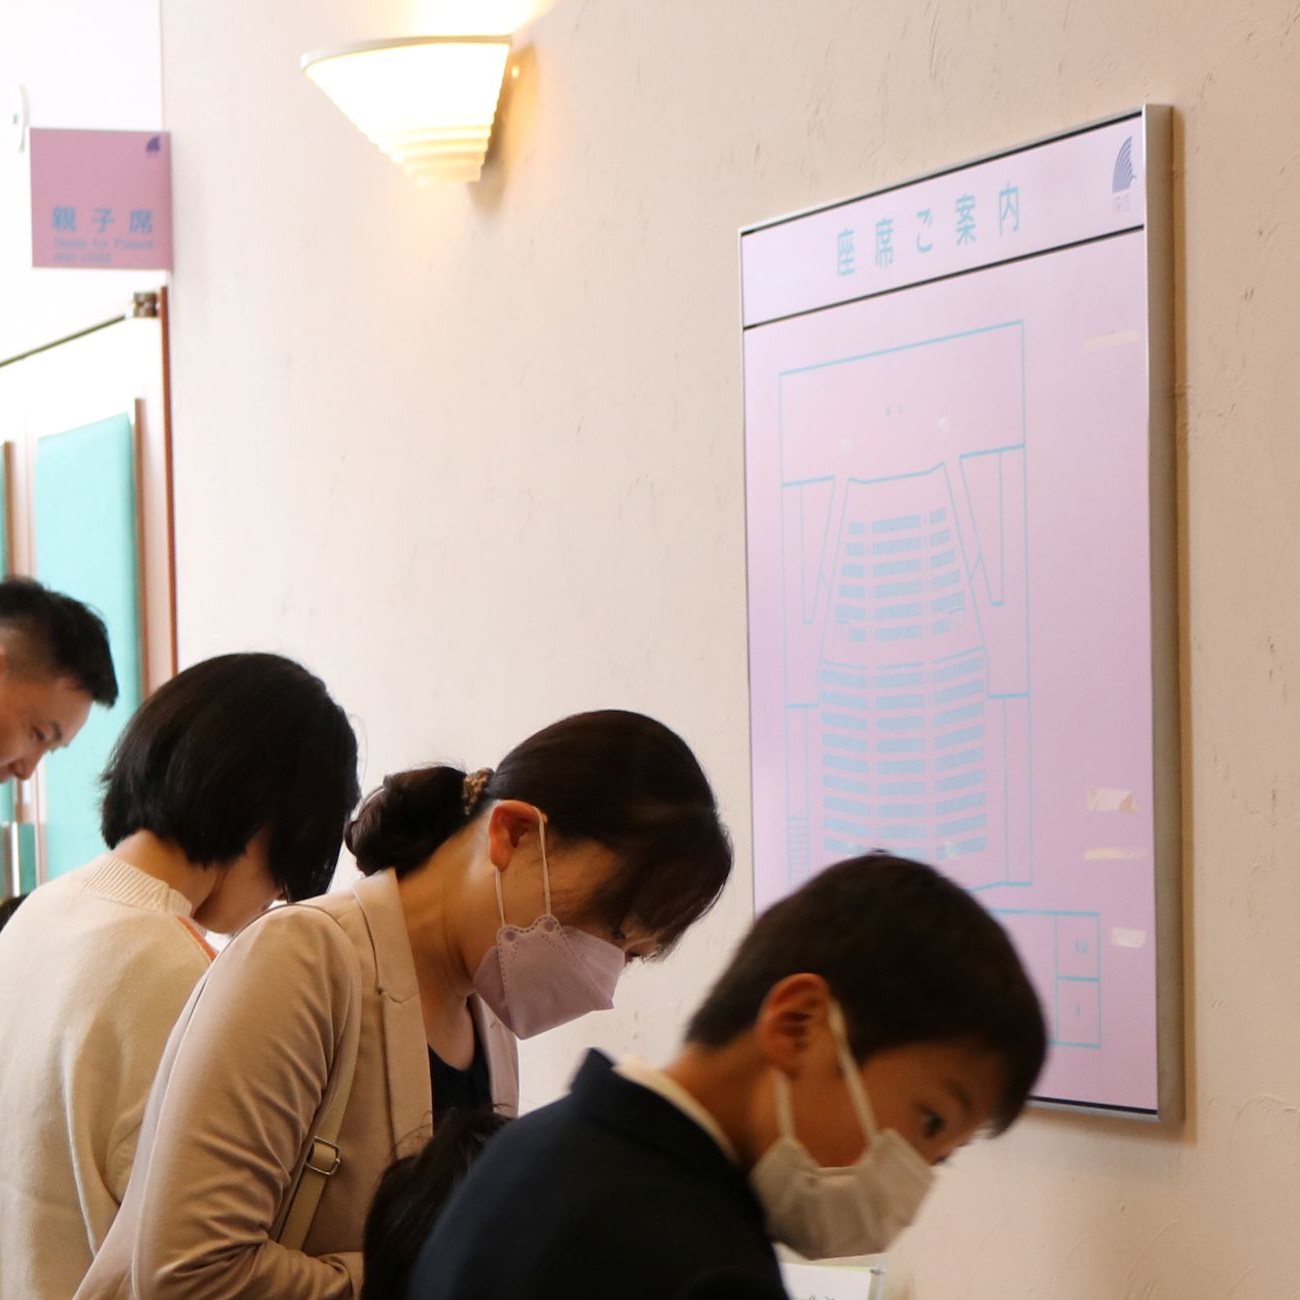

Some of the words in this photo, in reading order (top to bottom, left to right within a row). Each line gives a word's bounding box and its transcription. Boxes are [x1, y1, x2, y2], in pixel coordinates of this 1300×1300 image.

[52, 206, 156, 234] 親子席
[836, 181, 1021, 276] 座席ご案内
